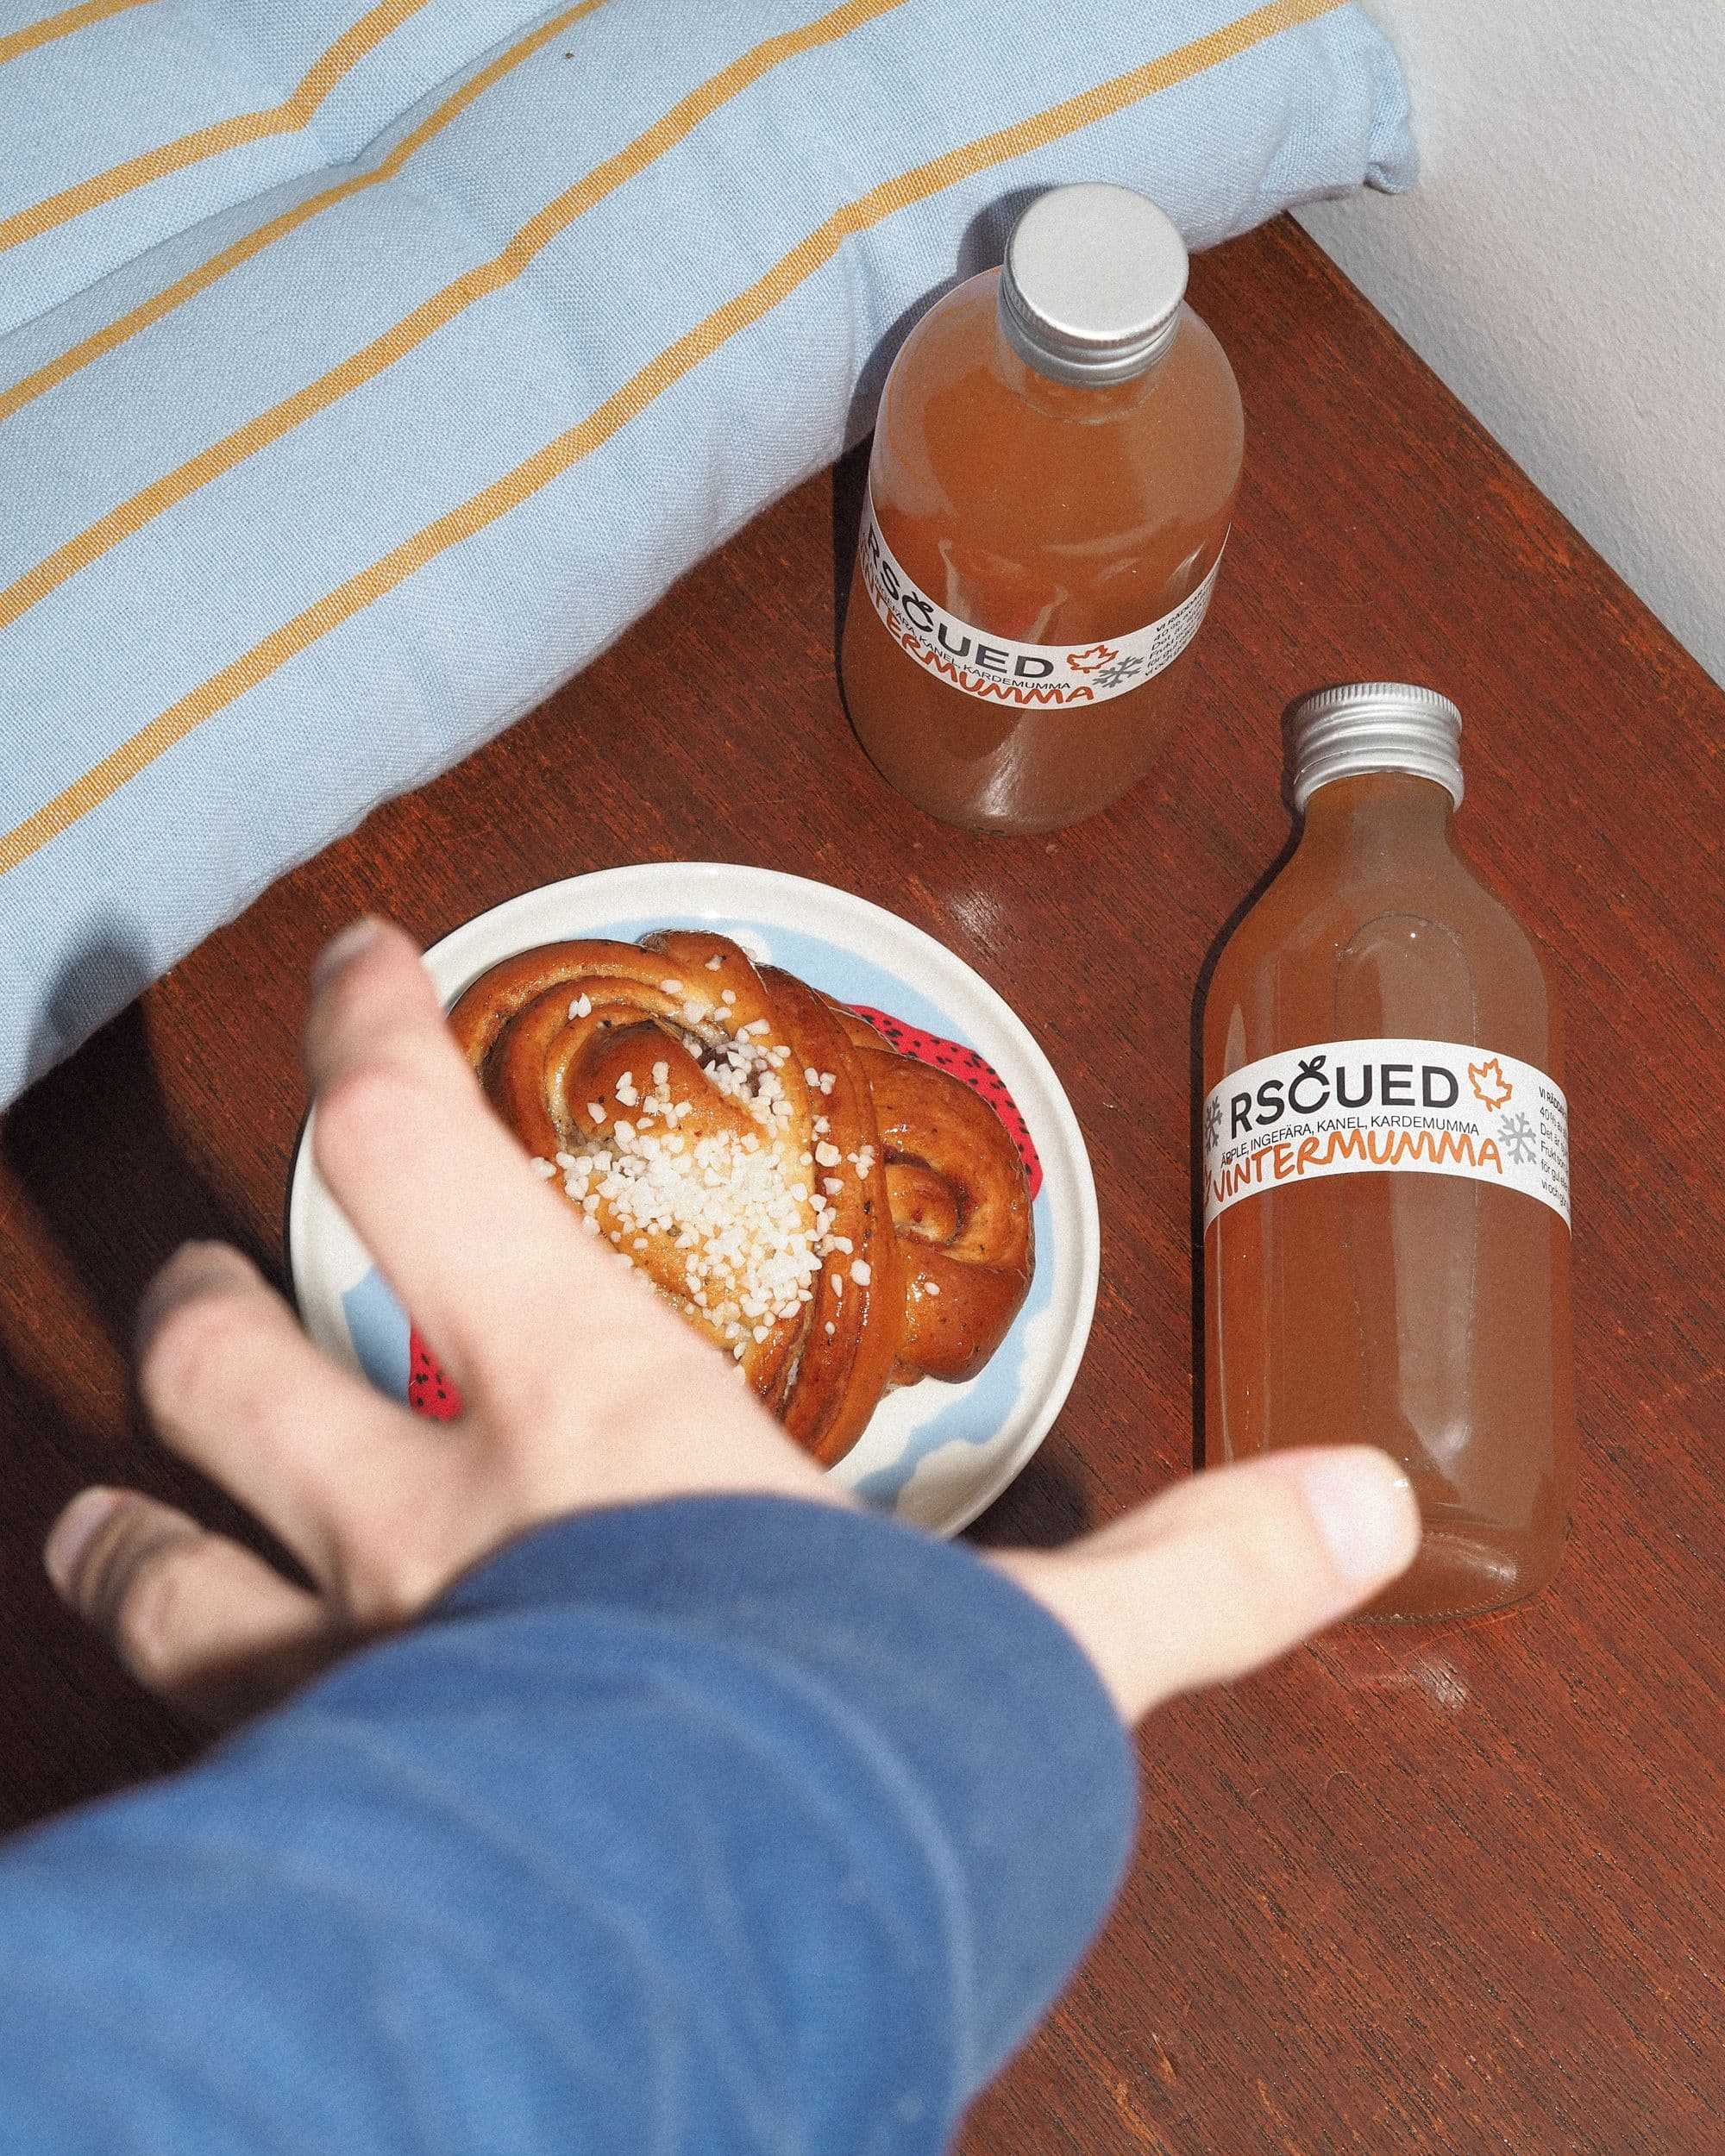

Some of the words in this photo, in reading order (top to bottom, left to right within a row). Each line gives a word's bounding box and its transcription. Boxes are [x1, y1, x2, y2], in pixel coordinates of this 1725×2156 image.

[868, 522, 1054, 678] RSCUED
[919, 636, 961, 669] KANEL,
[963, 664, 1071, 690] KARDEMUMMA
[1231, 1056, 1458, 1140] RSCUED
[1539, 1085, 1546, 1100] VI
[1220, 1142, 1249, 1169] ÄPPLE,
[1251, 1123, 1314, 1150] INGEFÄRA,
[1317, 1116, 1368, 1133] KANEL,
[1371, 1115, 1479, 1137] KARDEMUMMA
[1540, 1122, 1552, 1141] Det
[1214, 1129, 1502, 1202] VINTERMUMMA
[1540, 1158, 1551, 1174] för
